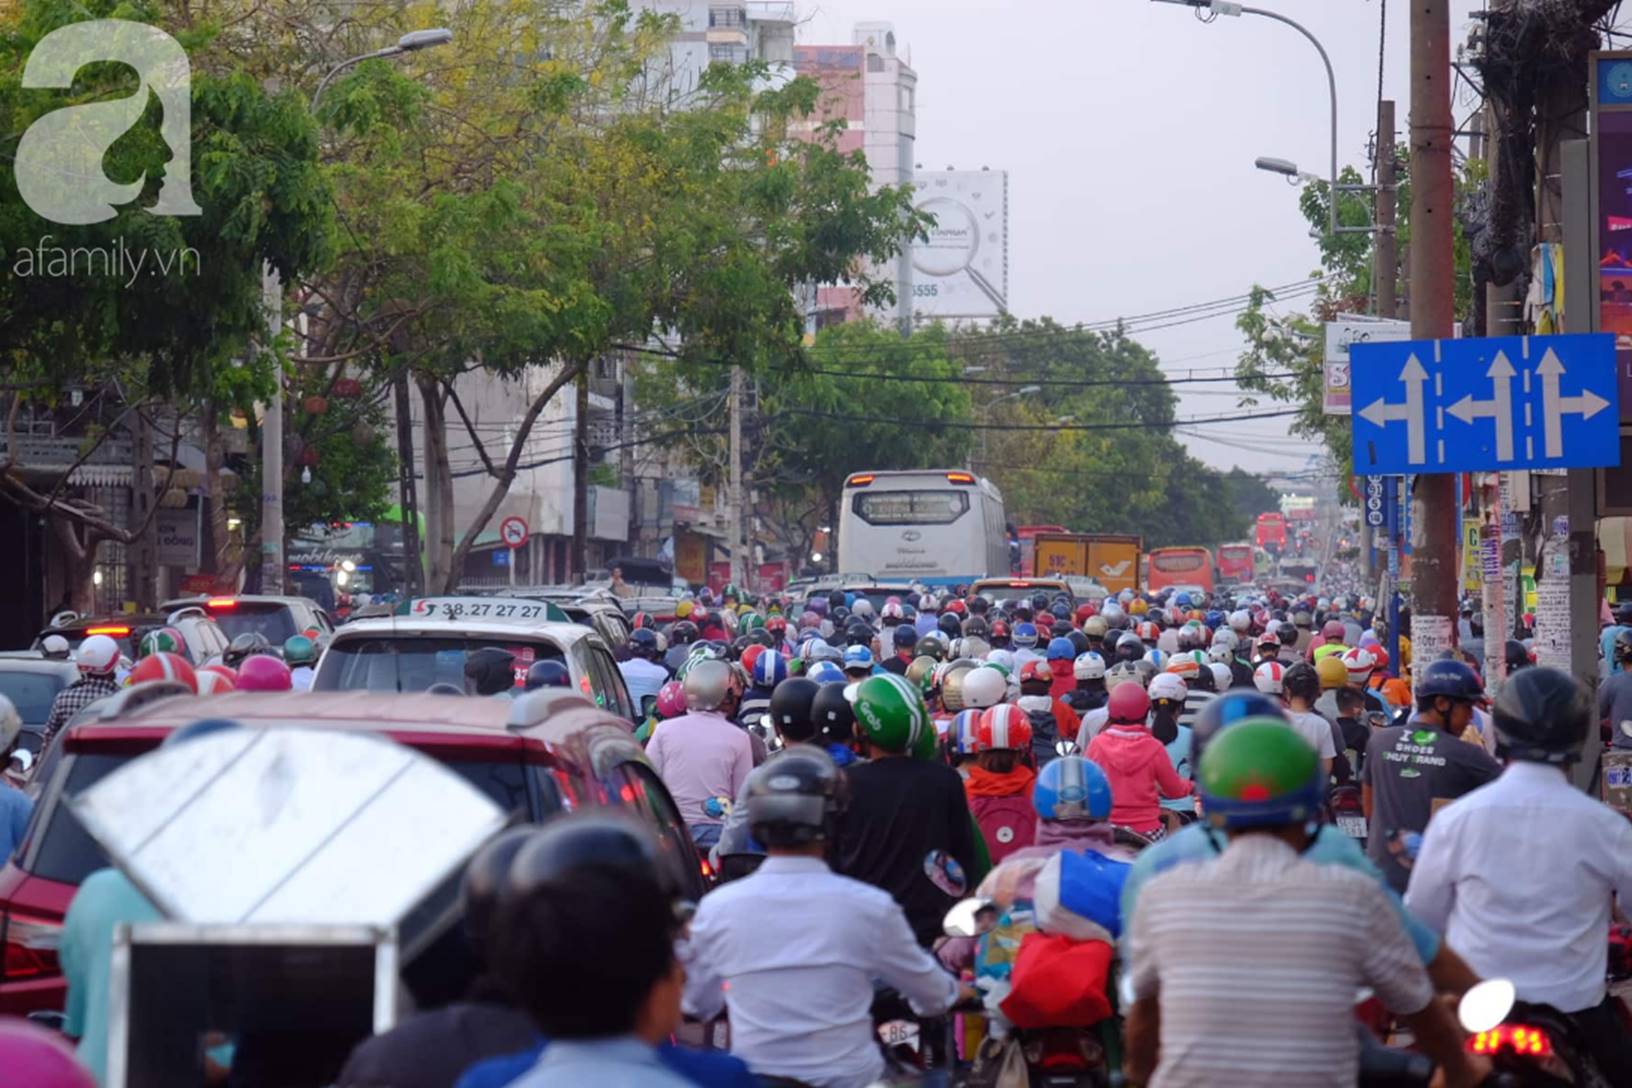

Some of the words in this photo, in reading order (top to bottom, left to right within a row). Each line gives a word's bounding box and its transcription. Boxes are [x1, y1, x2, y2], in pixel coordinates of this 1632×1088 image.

[442, 602, 492, 617] 38.27
[495, 603, 518, 617] 27
[520, 605, 542, 618] 27
[860, 702, 882, 731] Grab
